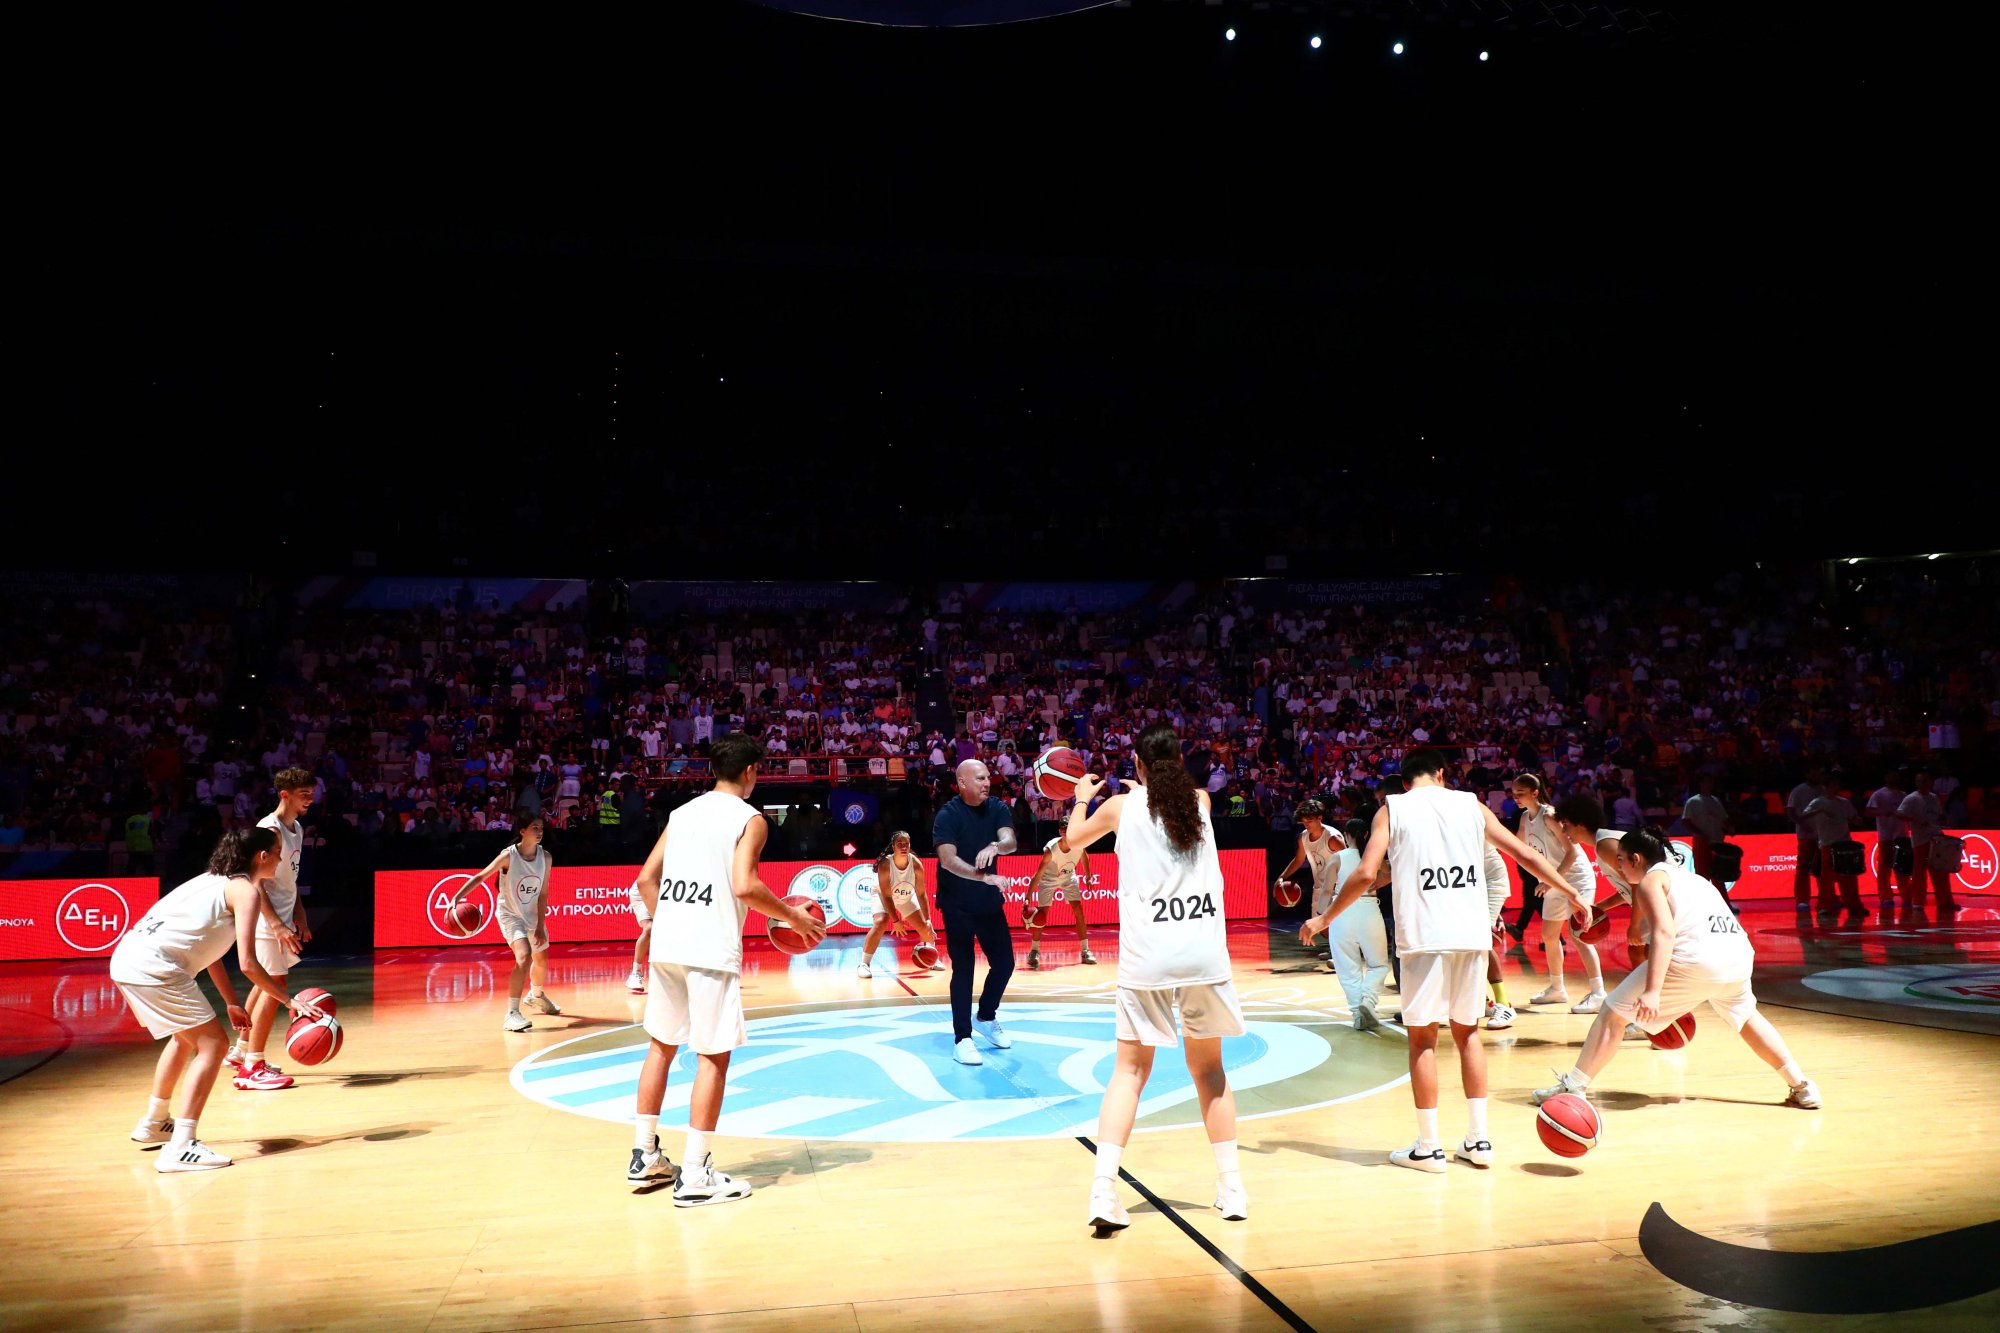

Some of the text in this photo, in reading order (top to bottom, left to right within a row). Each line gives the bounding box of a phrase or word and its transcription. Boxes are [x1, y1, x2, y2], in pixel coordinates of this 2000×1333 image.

[1420, 865, 1477, 891] 2024
[575, 887, 630, 899] ΕΠΙΣΗΜ
[660, 878, 713, 906] 2024
[64, 902, 118, 931] ΔΕΗ
[563, 903, 635, 917] ΠΡΟΟΛΥΜ
[1151, 893, 1217, 922] 2024
